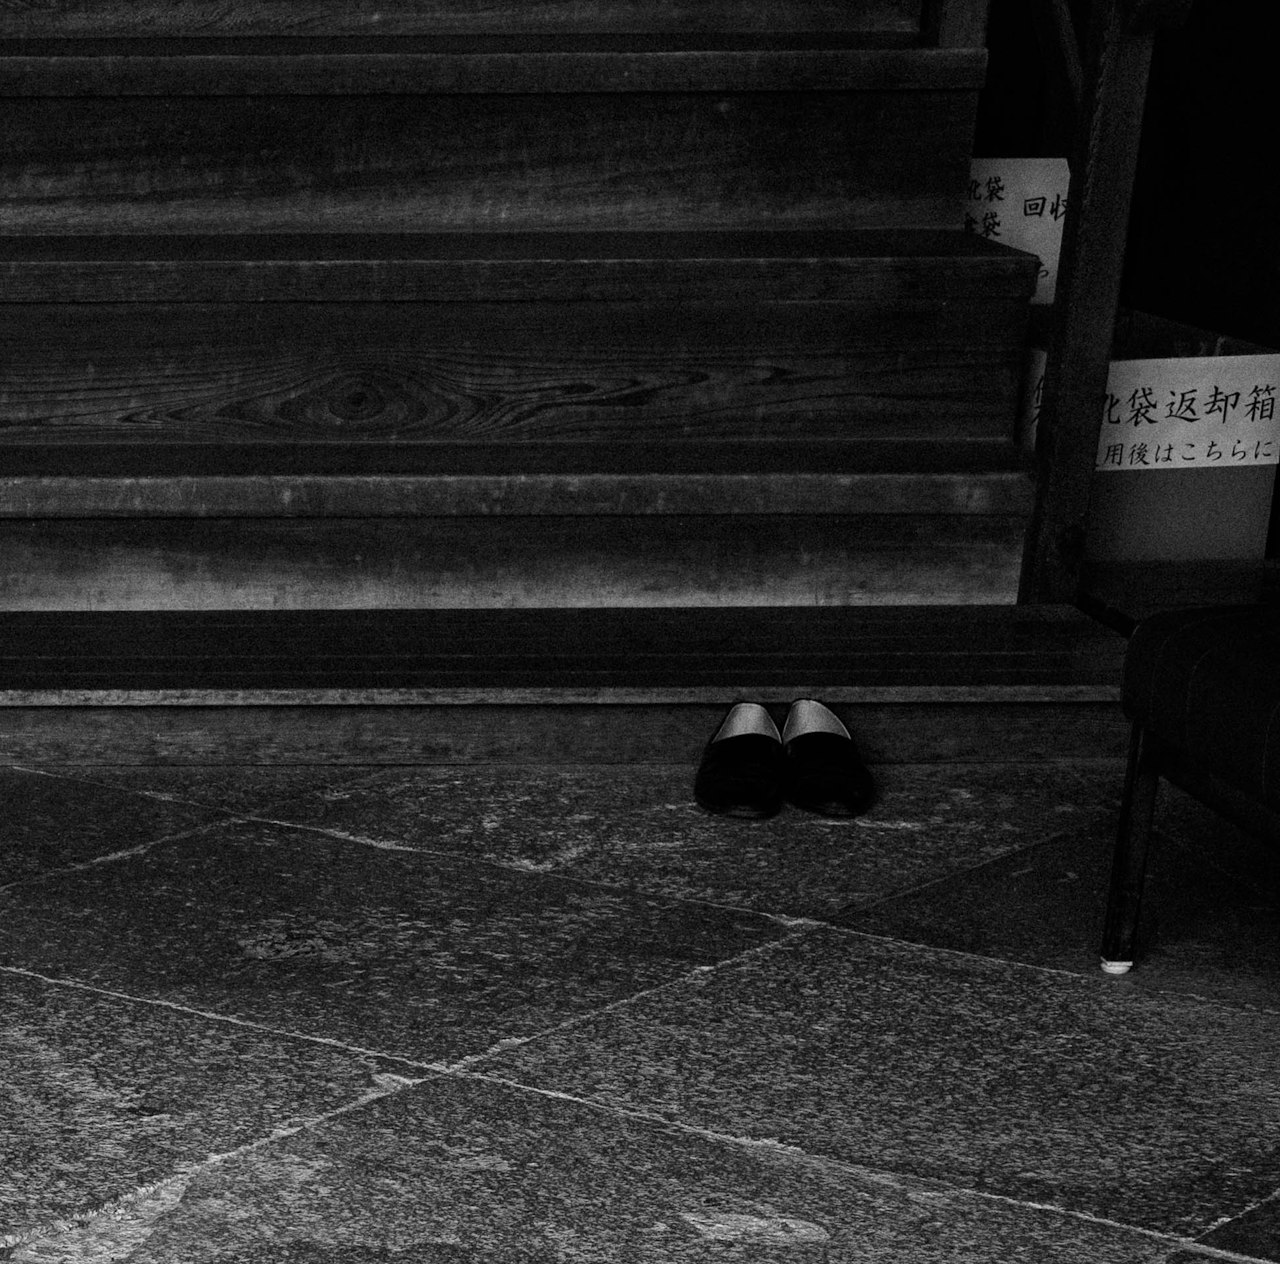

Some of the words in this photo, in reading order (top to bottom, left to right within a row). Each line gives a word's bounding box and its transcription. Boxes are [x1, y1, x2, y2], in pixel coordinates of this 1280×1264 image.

[1024, 194, 1067, 221] 回収
[1095, 439, 1273, 466] 用後はこちらに
